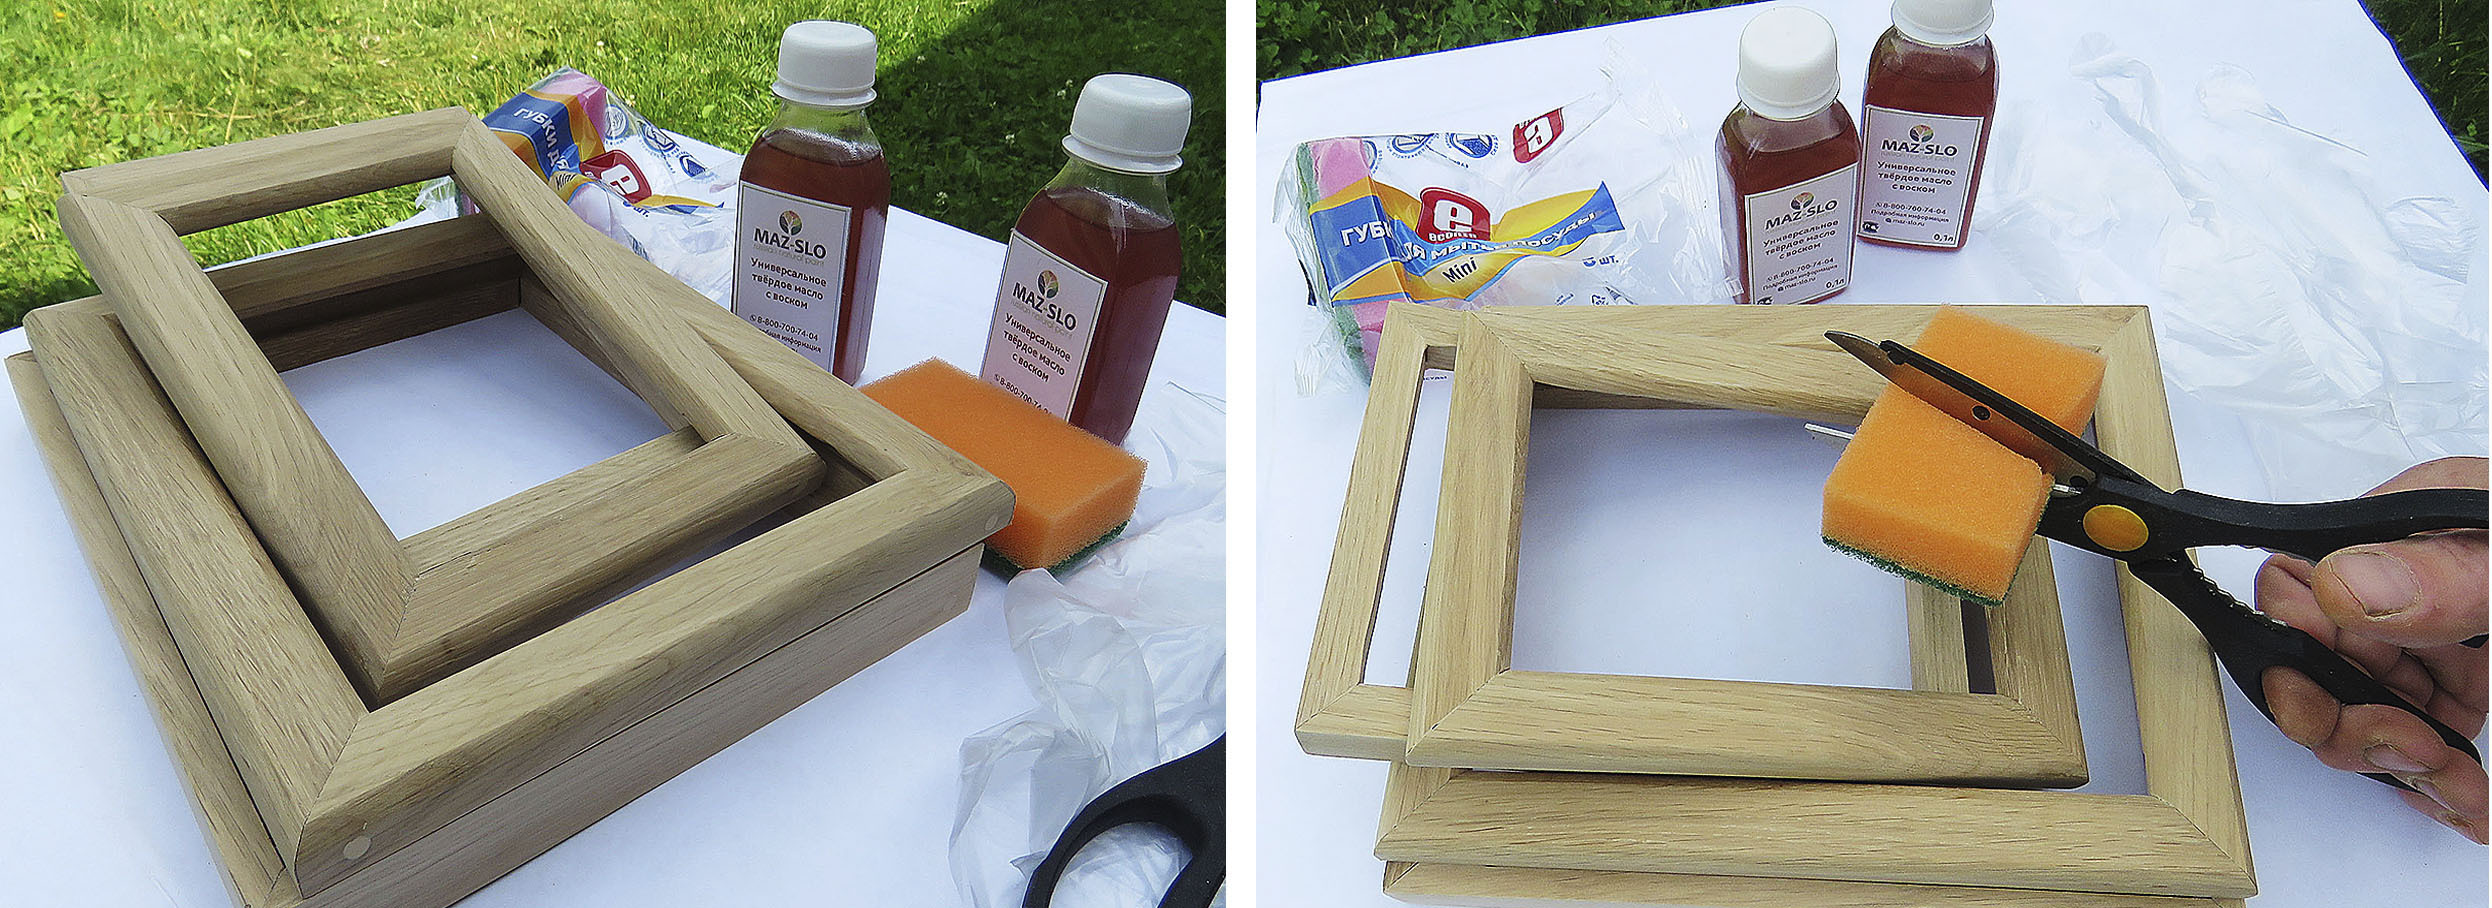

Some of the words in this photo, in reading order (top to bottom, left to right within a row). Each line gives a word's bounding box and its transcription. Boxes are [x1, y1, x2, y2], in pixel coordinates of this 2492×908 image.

[513, 108, 557, 148] ГУБКИ
[1882, 140, 1958, 156] MAZ-SLO
[1877, 161, 1956, 176] Универсальное
[1878, 172, 1920, 183] твёрдое
[1922, 177, 1952, 186] масло
[1900, 185, 1936, 193] воском
[1765, 200, 1838, 230] MAZ-SLO
[754, 228, 827, 259] MAZ-SLO
[1763, 220, 1839, 247] Универсальное
[1766, 240, 1804, 255] твёрдое
[1806, 230, 1836, 242] масло
[1934, 233, 1954, 242] 0,1л
[1400, 242, 1427, 261] ЛЯ
[1431, 241, 1508, 260] МЫТЬ
[1599, 255, 1619, 265] шт.
[1786, 243, 1821, 257] воском
[751, 257, 827, 287] Универсальное
[1442, 256, 1479, 282] Mini
[752, 273, 792, 291] твёрдое
[794, 285, 823, 300] масло
[1826, 278, 1845, 289] 0,1л
[765, 290, 772, 299] с
[773, 293, 808, 309] воском
[1013, 282, 1077, 331] MAZ-SLO
[757, 315, 818, 341] 8-800-700-74-04
[1006, 313, 1071, 362] Универсальное
[781, 335, 822, 353] информация
[1004, 330, 1038, 359] твёрдое
[1039, 352, 1065, 376] масло
[1012, 353, 1017, 361] с
[1018, 357, 1049, 382] воском
